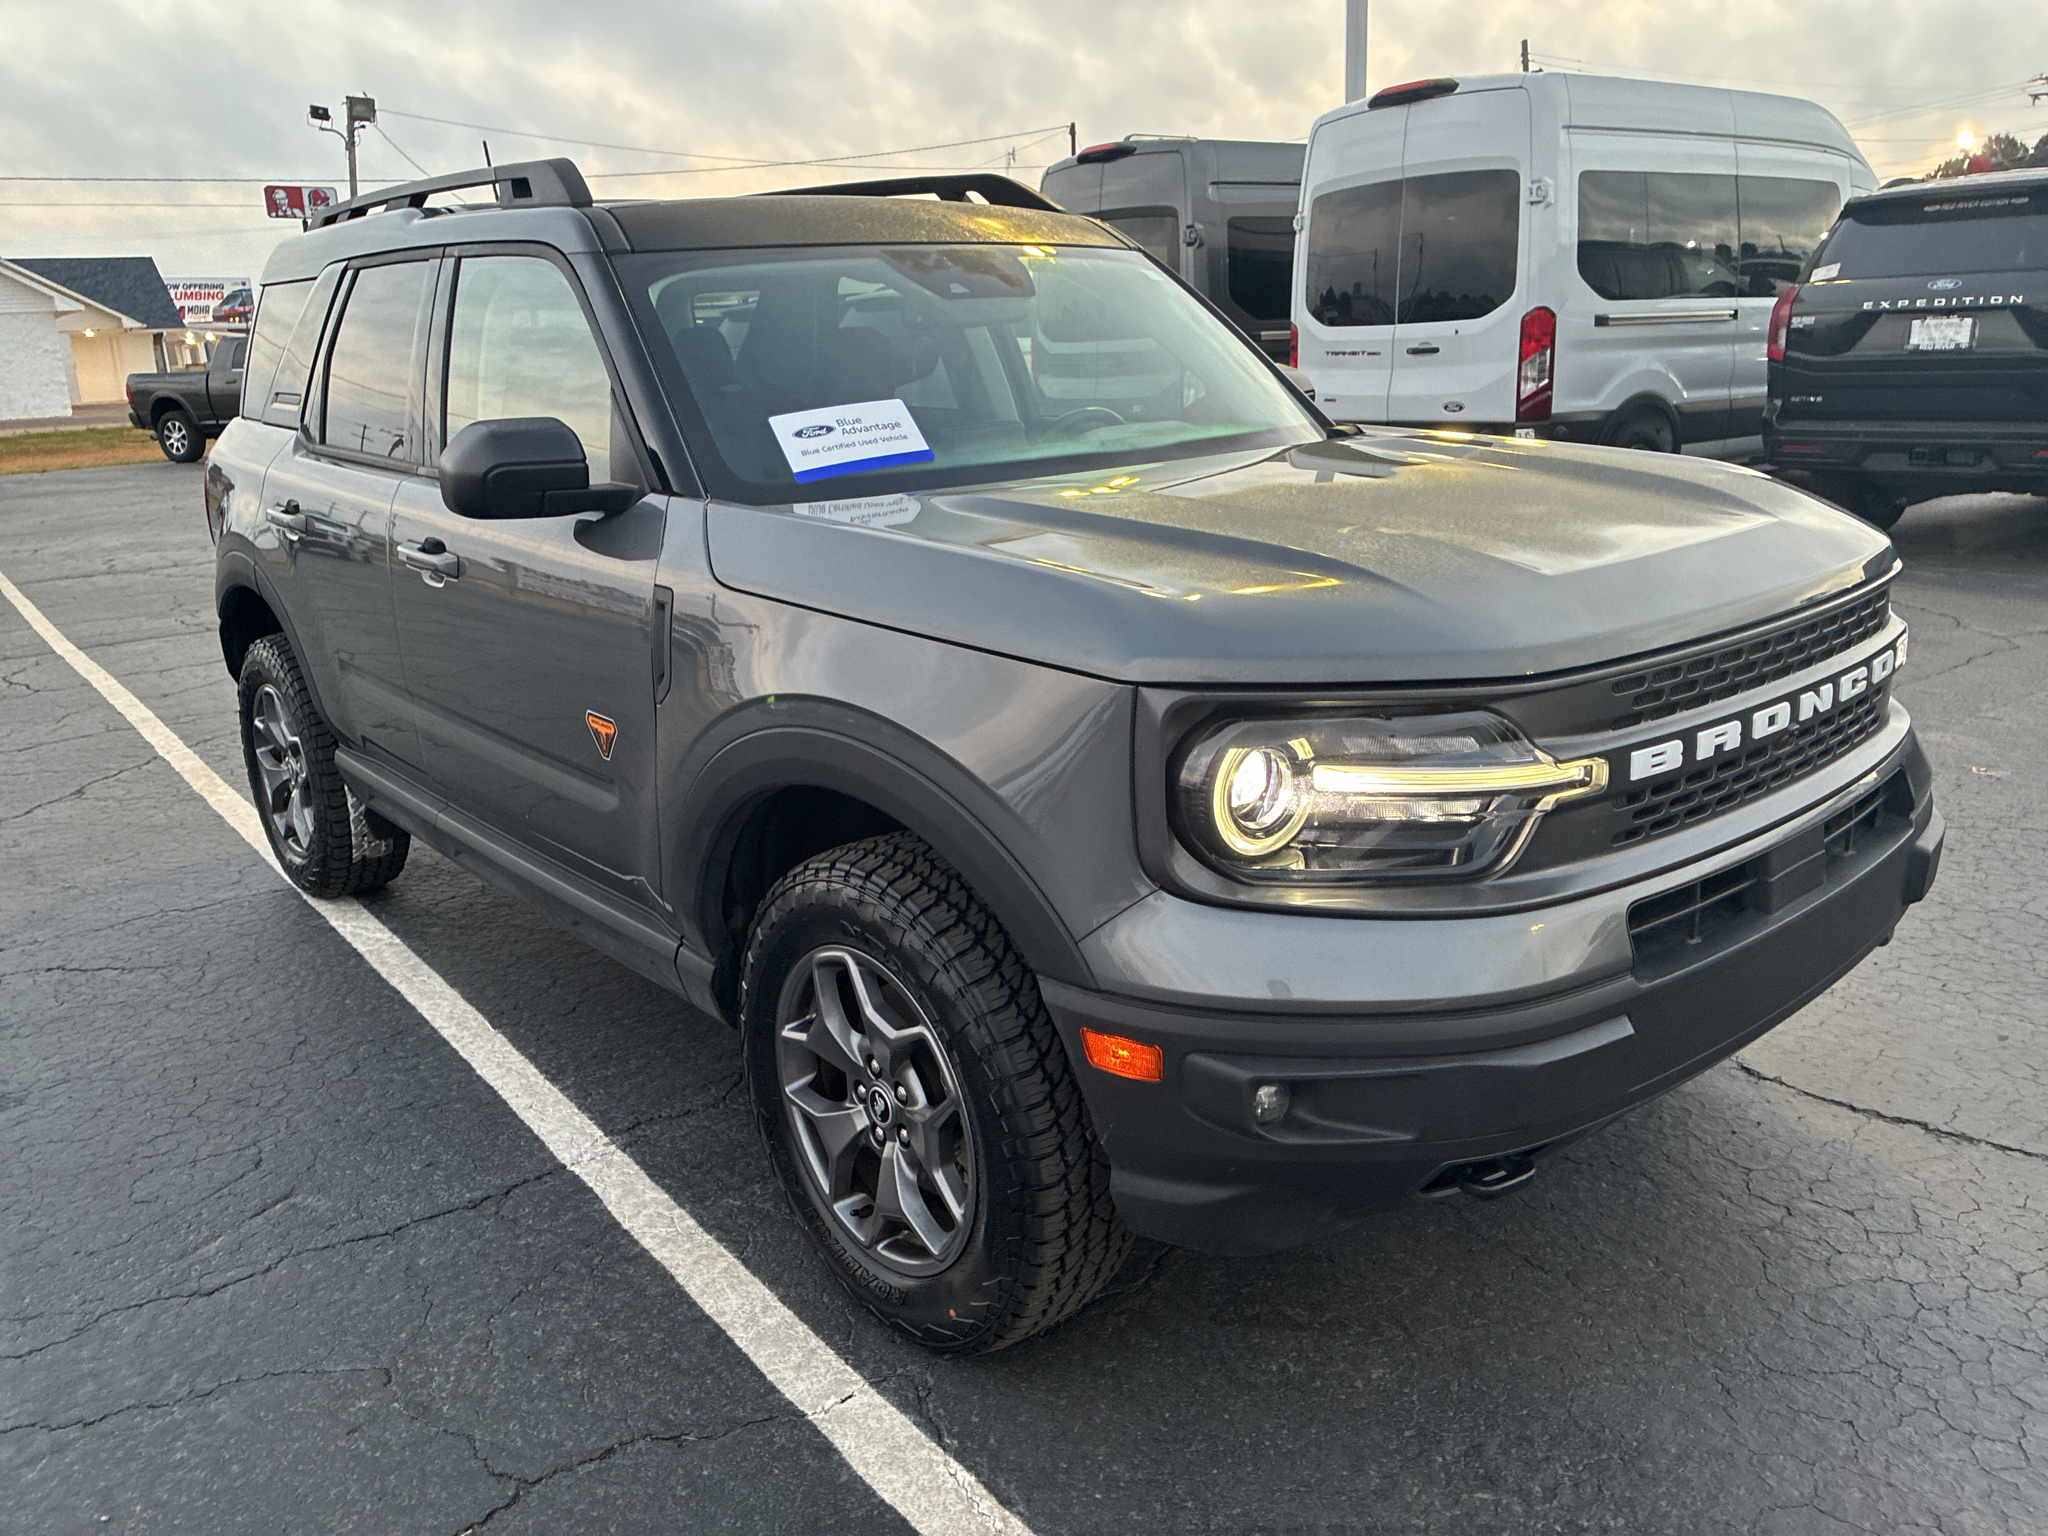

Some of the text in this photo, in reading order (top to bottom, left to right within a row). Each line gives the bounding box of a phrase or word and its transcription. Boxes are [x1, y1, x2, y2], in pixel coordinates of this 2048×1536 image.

[173, 290, 225, 301] UMBING
[1862, 295, 2024, 310] EXPEDITION
[835, 416, 863, 428] Blue
[841, 420, 902, 436] Advantage
[798, 426, 831, 439] Ford
[801, 434, 908, 457] Blue Certified Used Vehicle
[1629, 649, 1894, 781] BRONCO
